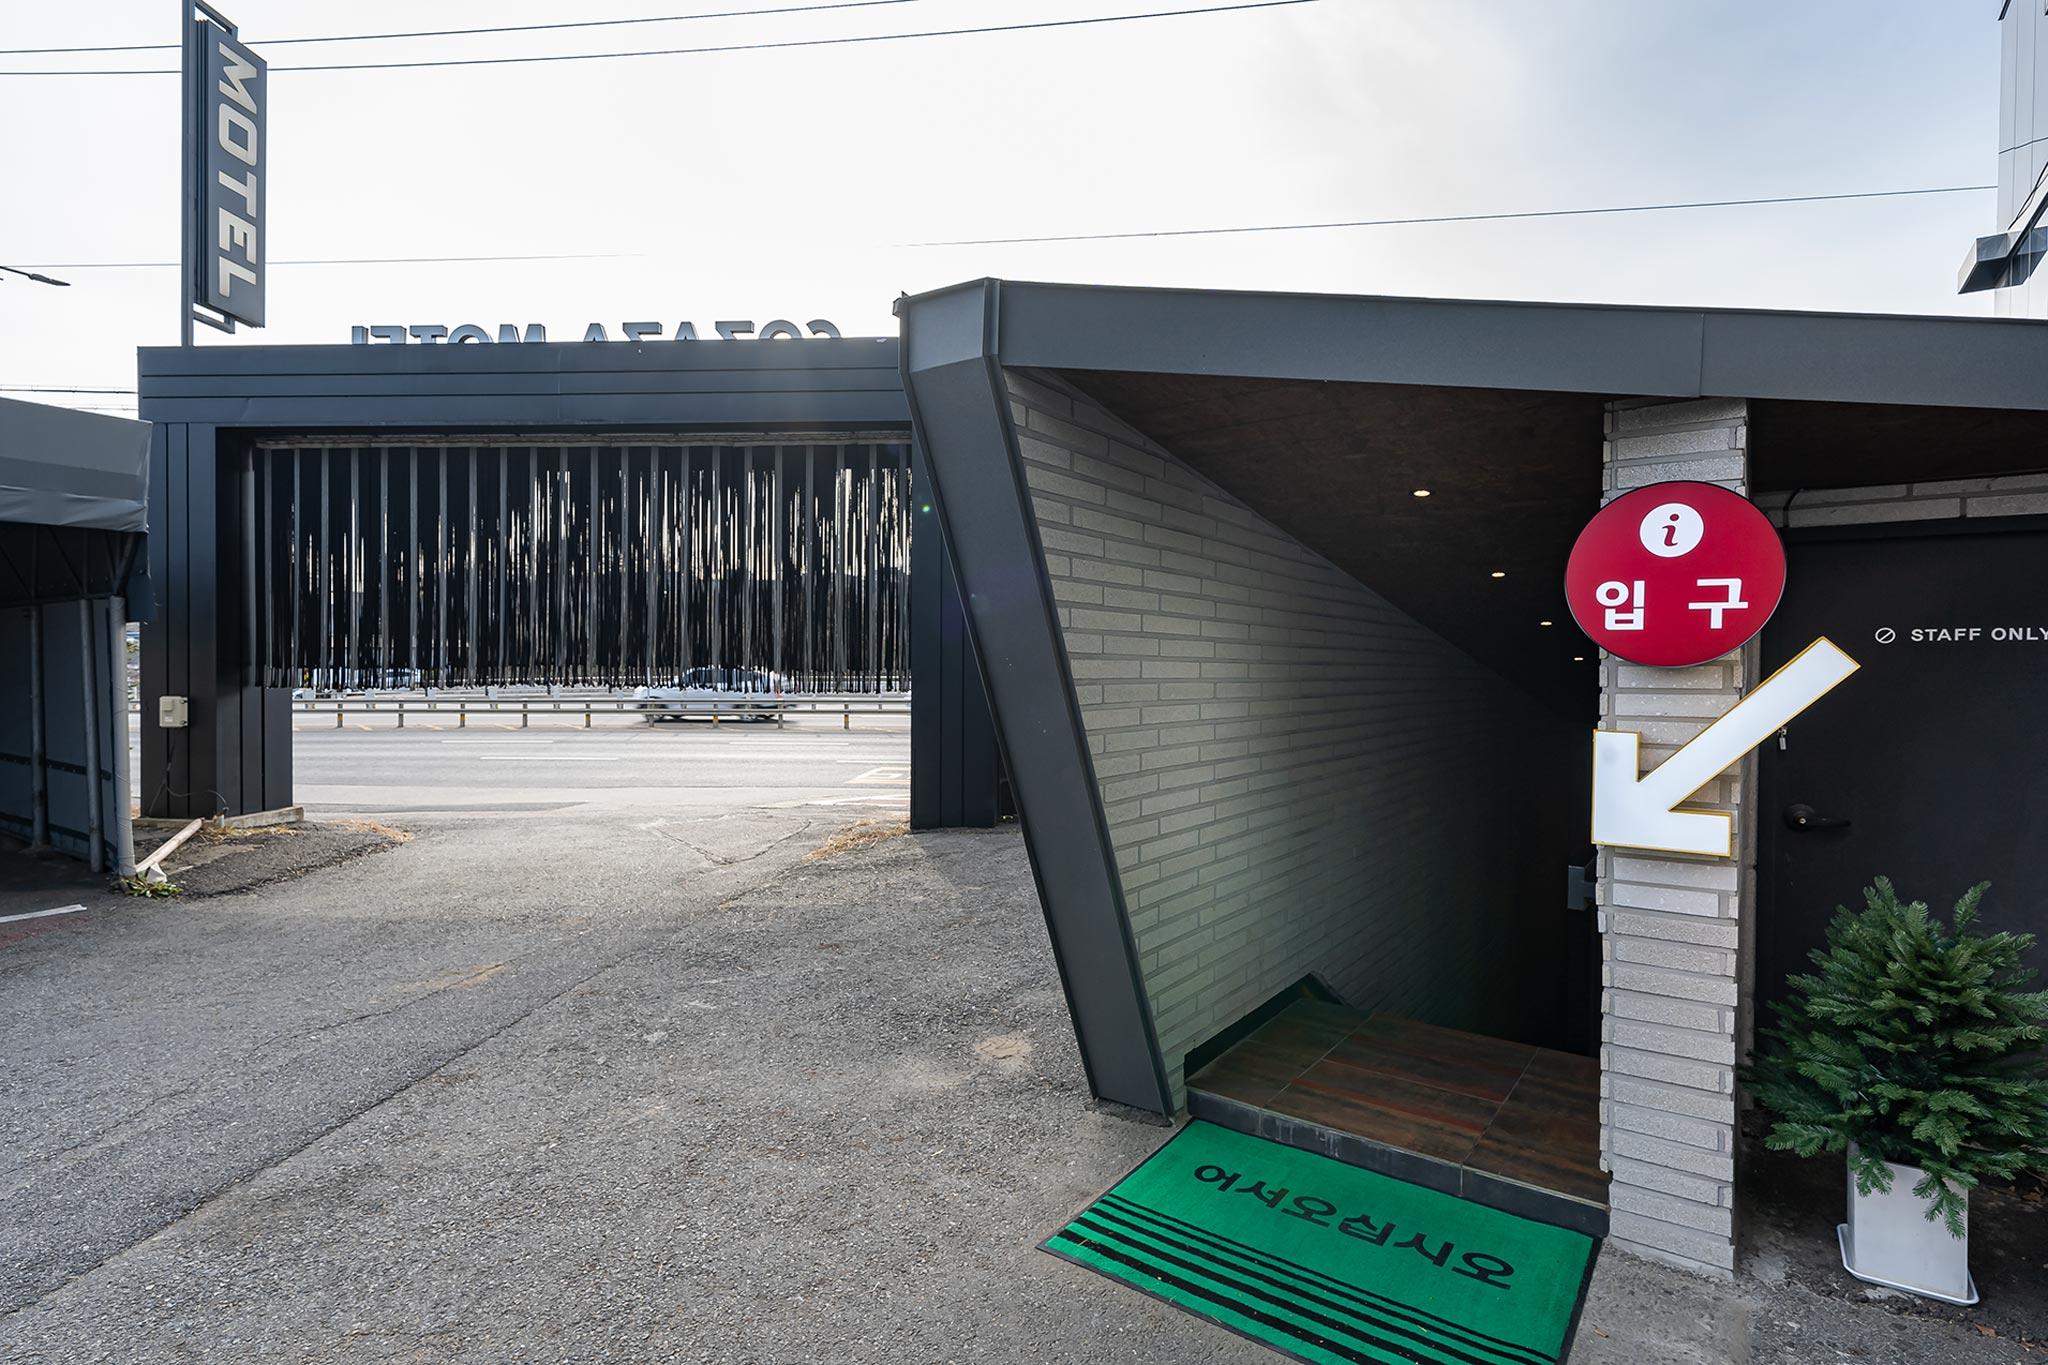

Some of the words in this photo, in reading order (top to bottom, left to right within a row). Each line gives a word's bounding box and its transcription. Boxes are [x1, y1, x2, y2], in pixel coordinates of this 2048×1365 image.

[218, 41, 257, 298] MOTEL
[1910, 627, 1982, 642] STAFF
[1990, 626, 2048, 641] ONLY
[1193, 1164, 1516, 1291] 어서오십시오
